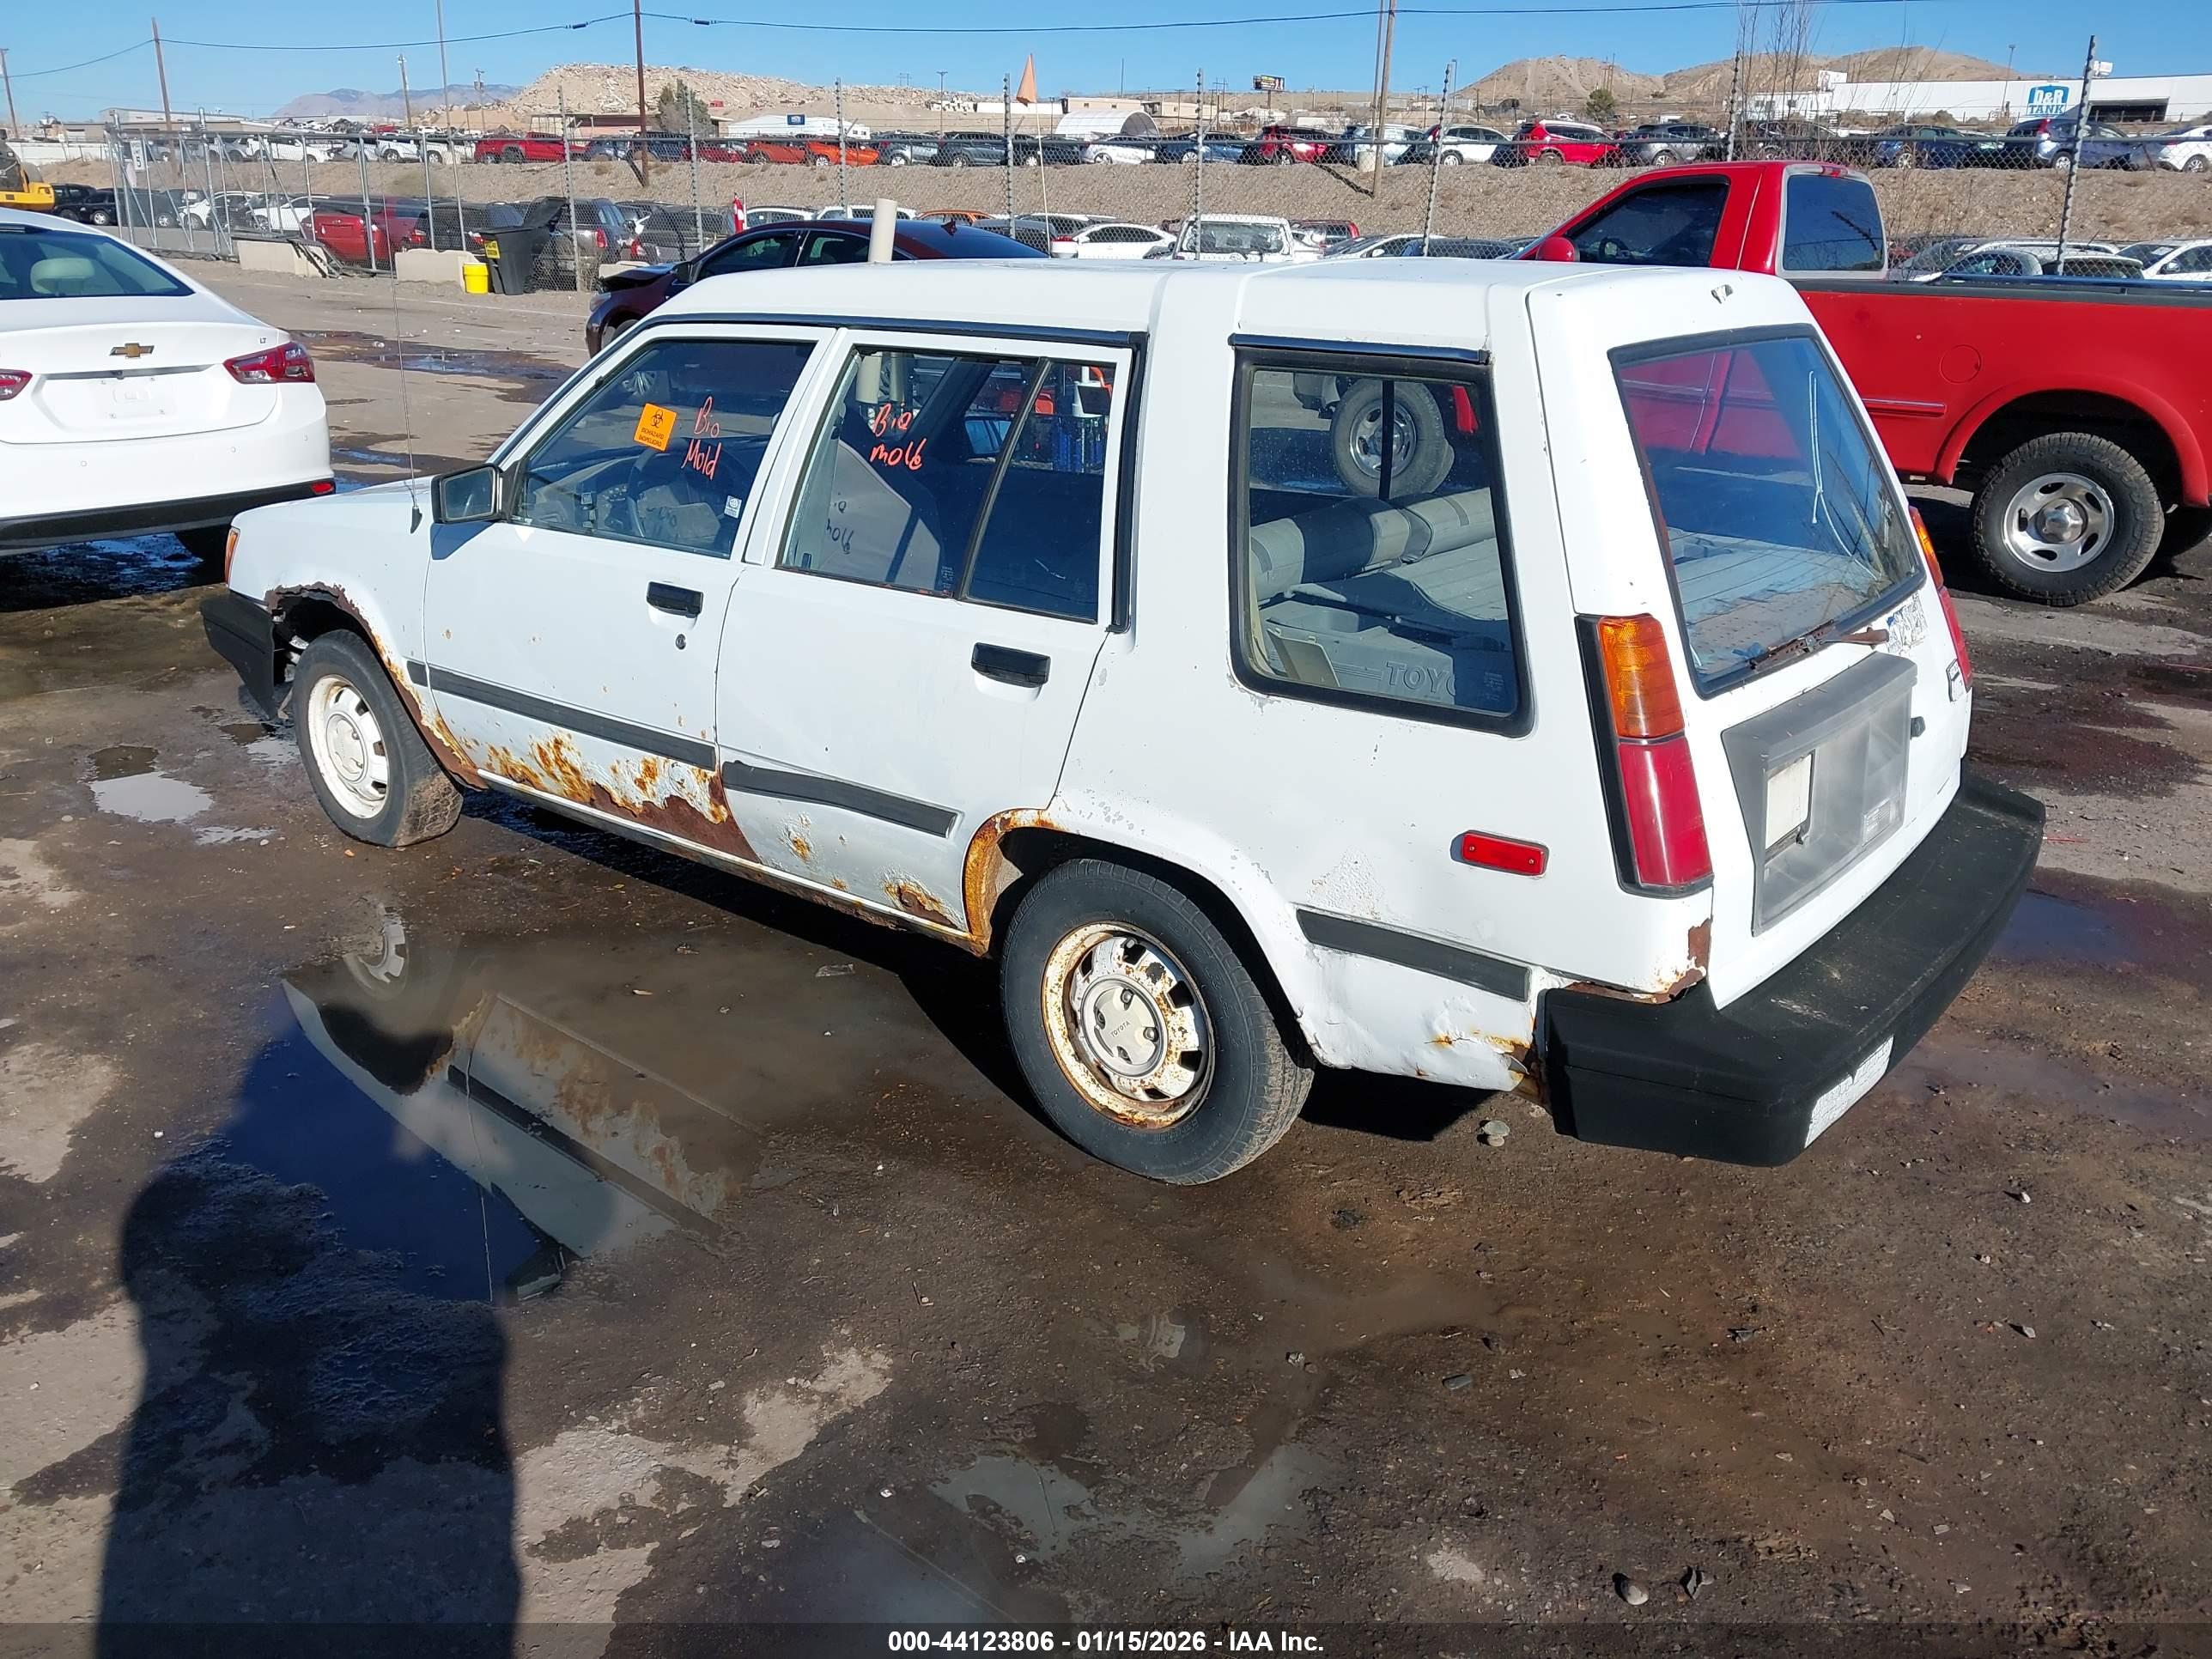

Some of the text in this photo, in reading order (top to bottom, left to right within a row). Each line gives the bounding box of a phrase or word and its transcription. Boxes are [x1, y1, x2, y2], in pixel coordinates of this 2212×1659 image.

[2033, 89, 2064, 104] D&R
[2028, 104, 2066, 113] TANK
[694, 396, 720, 438] Bio
[1109, 1020, 1131, 1038] TOYOTA
